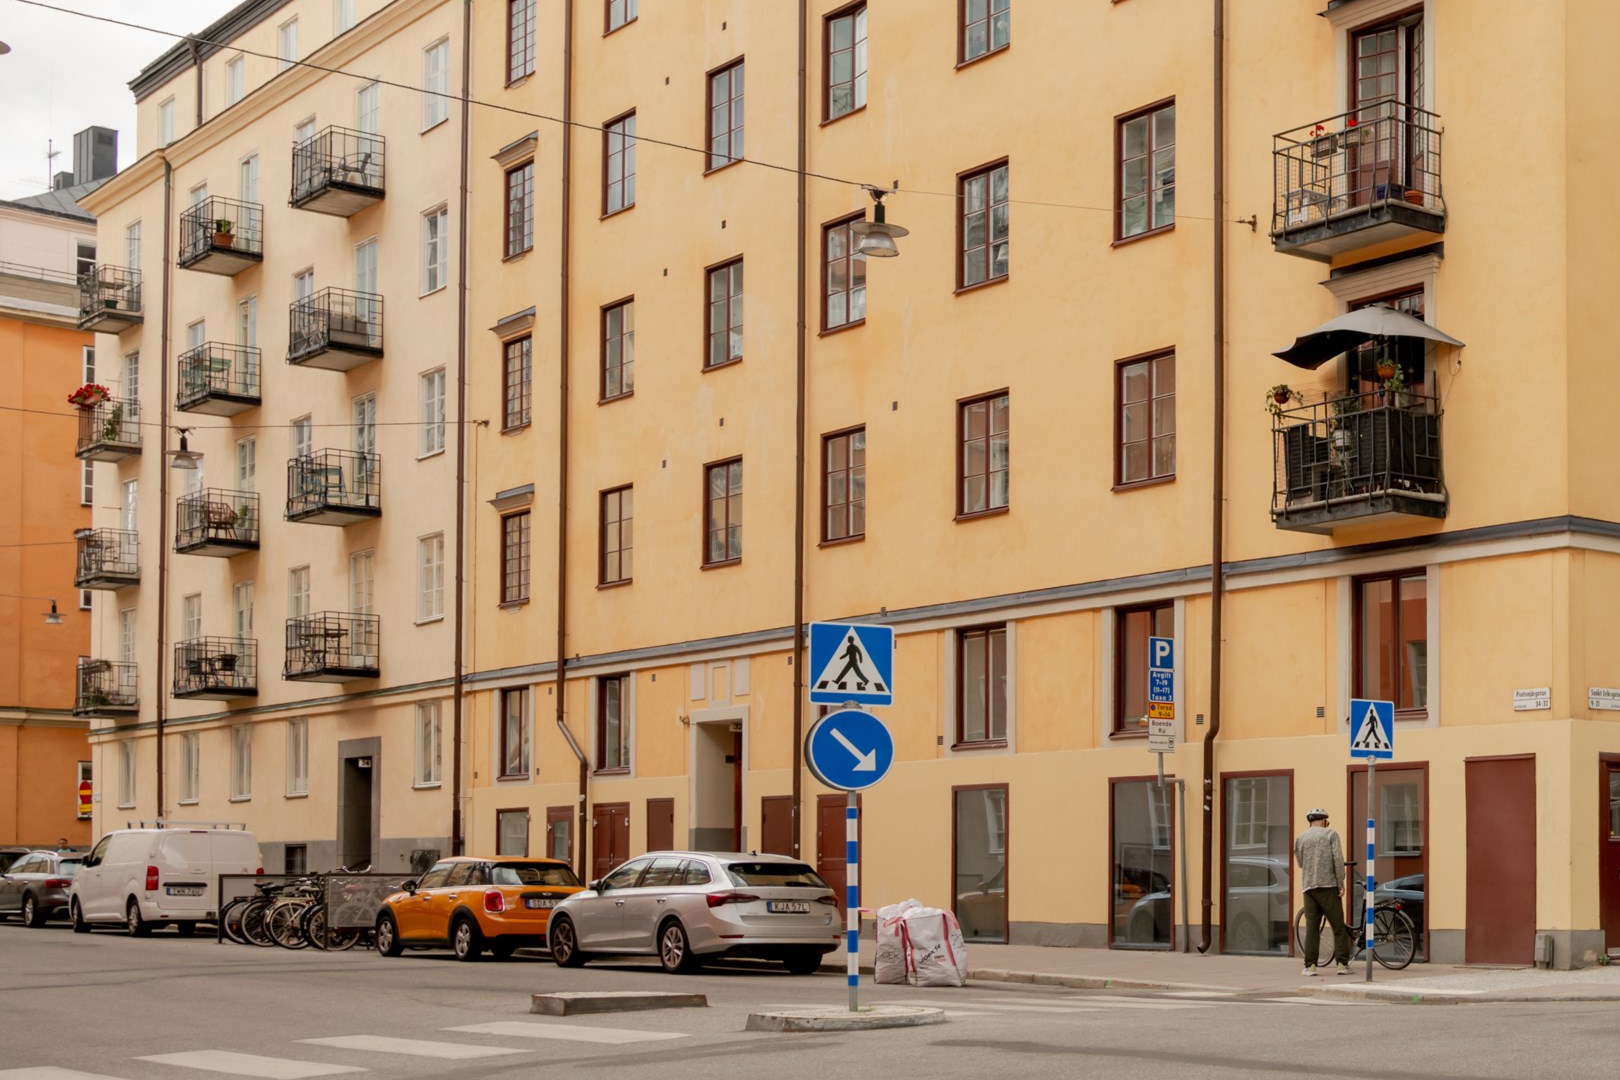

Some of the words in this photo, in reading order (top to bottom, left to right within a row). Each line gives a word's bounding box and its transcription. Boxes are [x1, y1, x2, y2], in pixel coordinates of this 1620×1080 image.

[1155, 641, 1170, 666] P
[1152, 671, 1171, 680] Avgift
[1153, 686, 1170, 694] (11-17)
[774, 902, 790, 911] KJA
[792, 902, 807, 911] 57L
